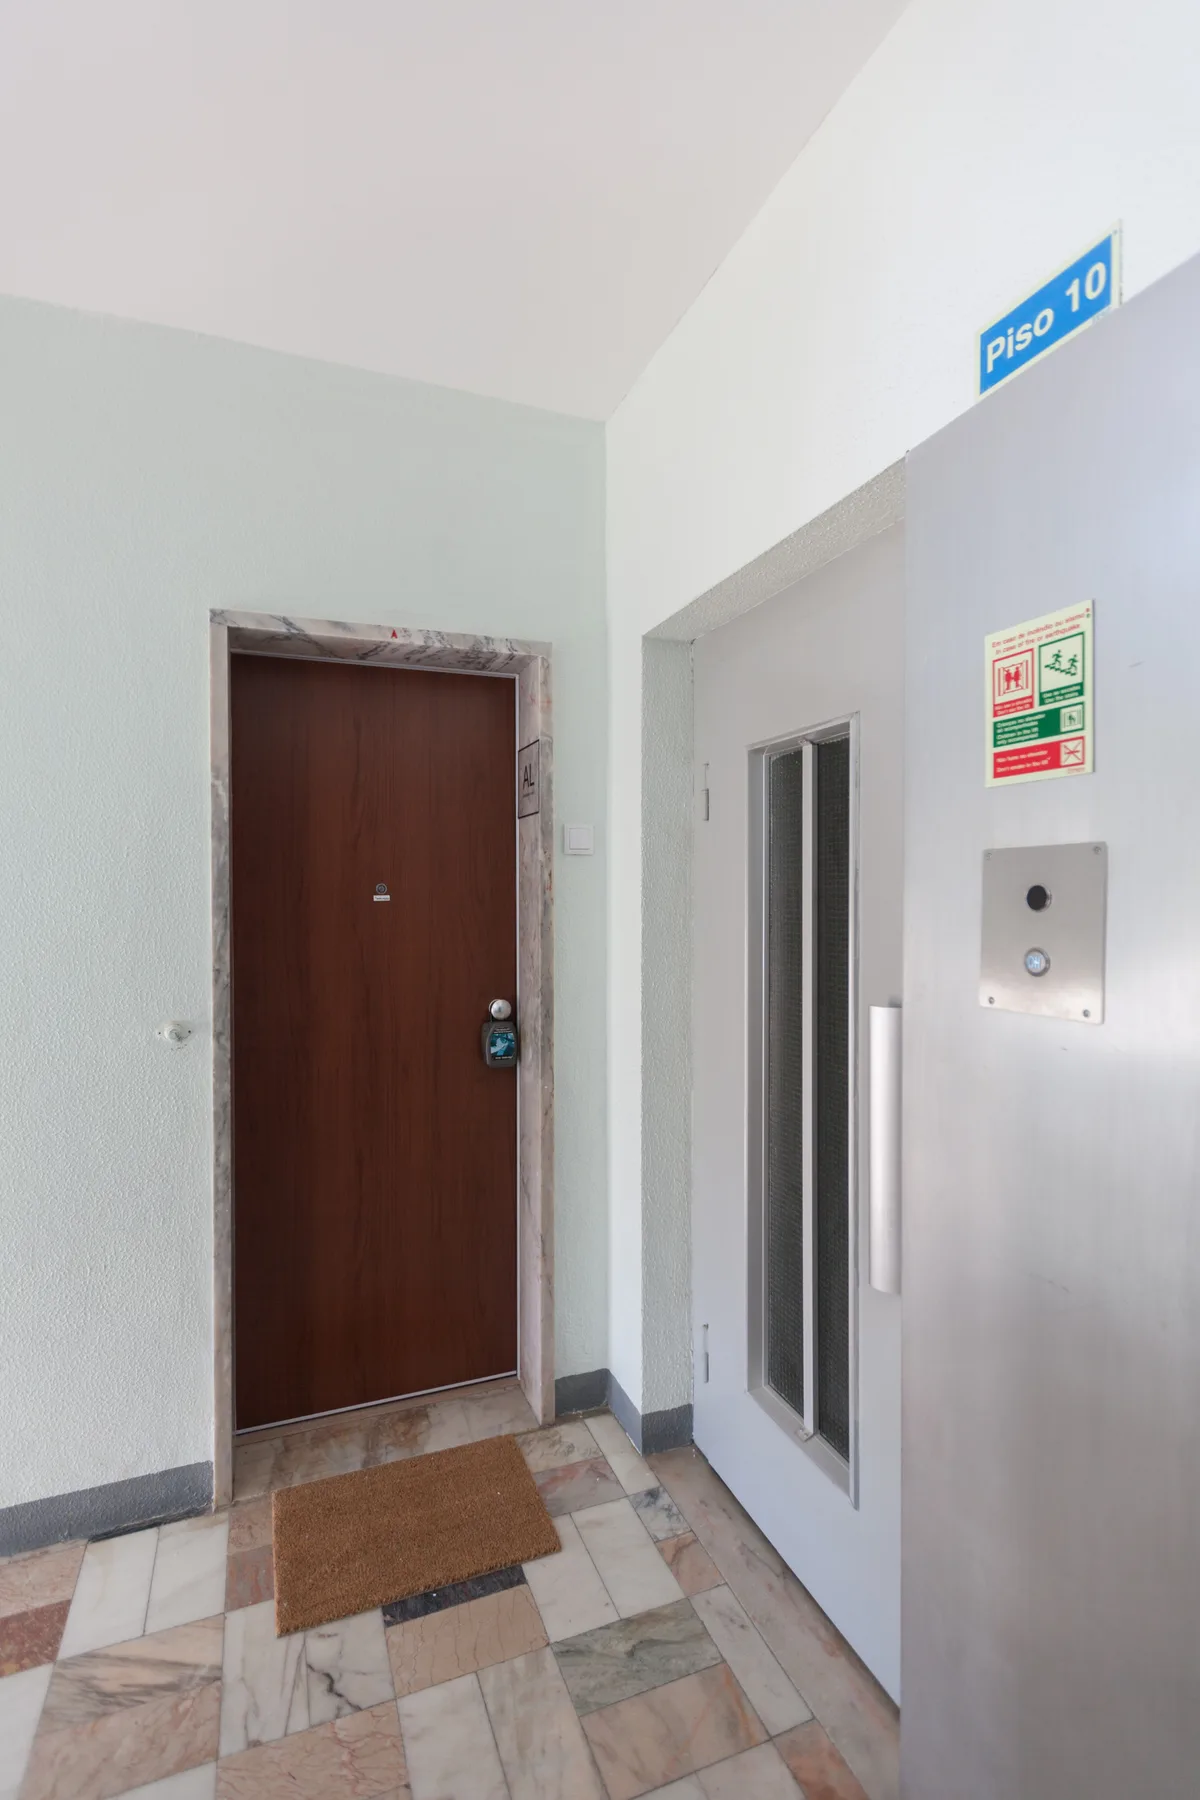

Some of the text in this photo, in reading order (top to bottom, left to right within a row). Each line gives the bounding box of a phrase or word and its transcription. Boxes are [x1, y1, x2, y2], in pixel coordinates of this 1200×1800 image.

[987, 261, 1107, 373] Piso 10
[1045, 624, 1081, 639] earthquake
[523, 763, 535, 790] AL
